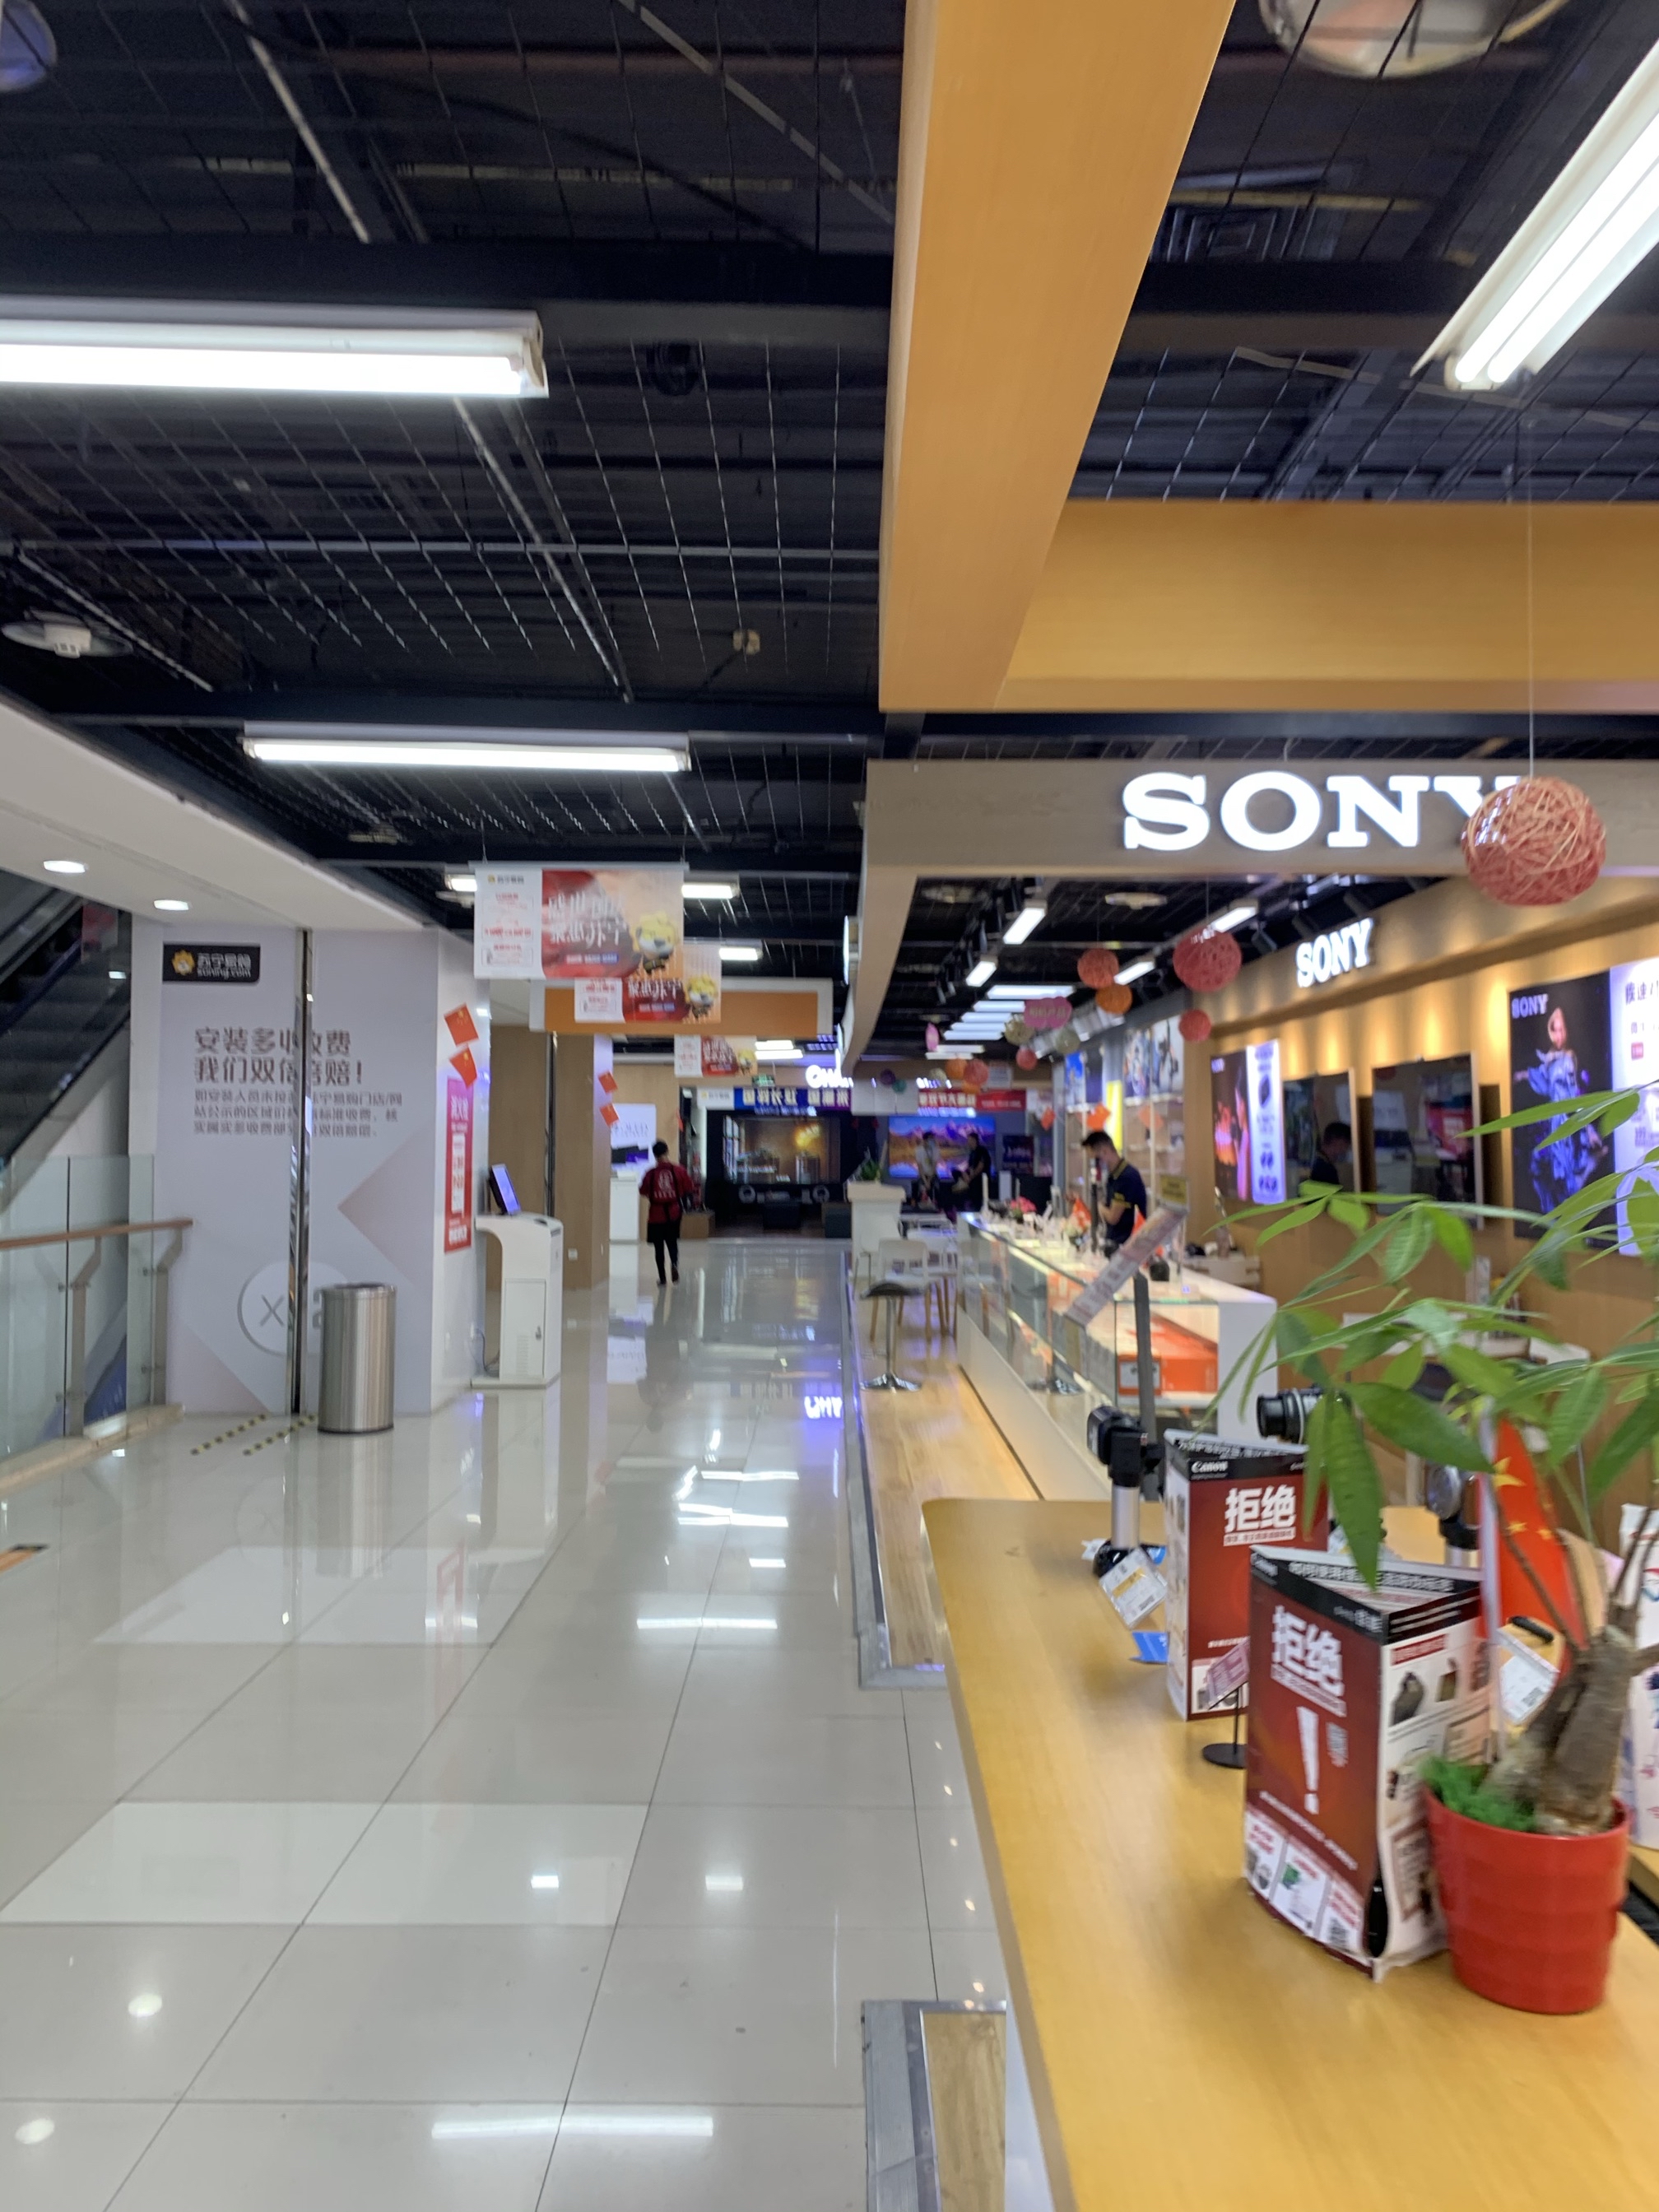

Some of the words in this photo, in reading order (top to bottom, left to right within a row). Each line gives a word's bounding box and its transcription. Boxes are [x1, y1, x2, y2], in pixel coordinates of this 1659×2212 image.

[198, 953, 251, 969] 苏宁易购
[1296, 918, 1373, 988] SONY
[1512, 993, 1549, 1019] SONY
[1192, 1461, 1229, 1474] Canon
[1224, 1484, 1297, 1533] 拒绝
[1272, 1605, 1345, 1697] 拒绝
